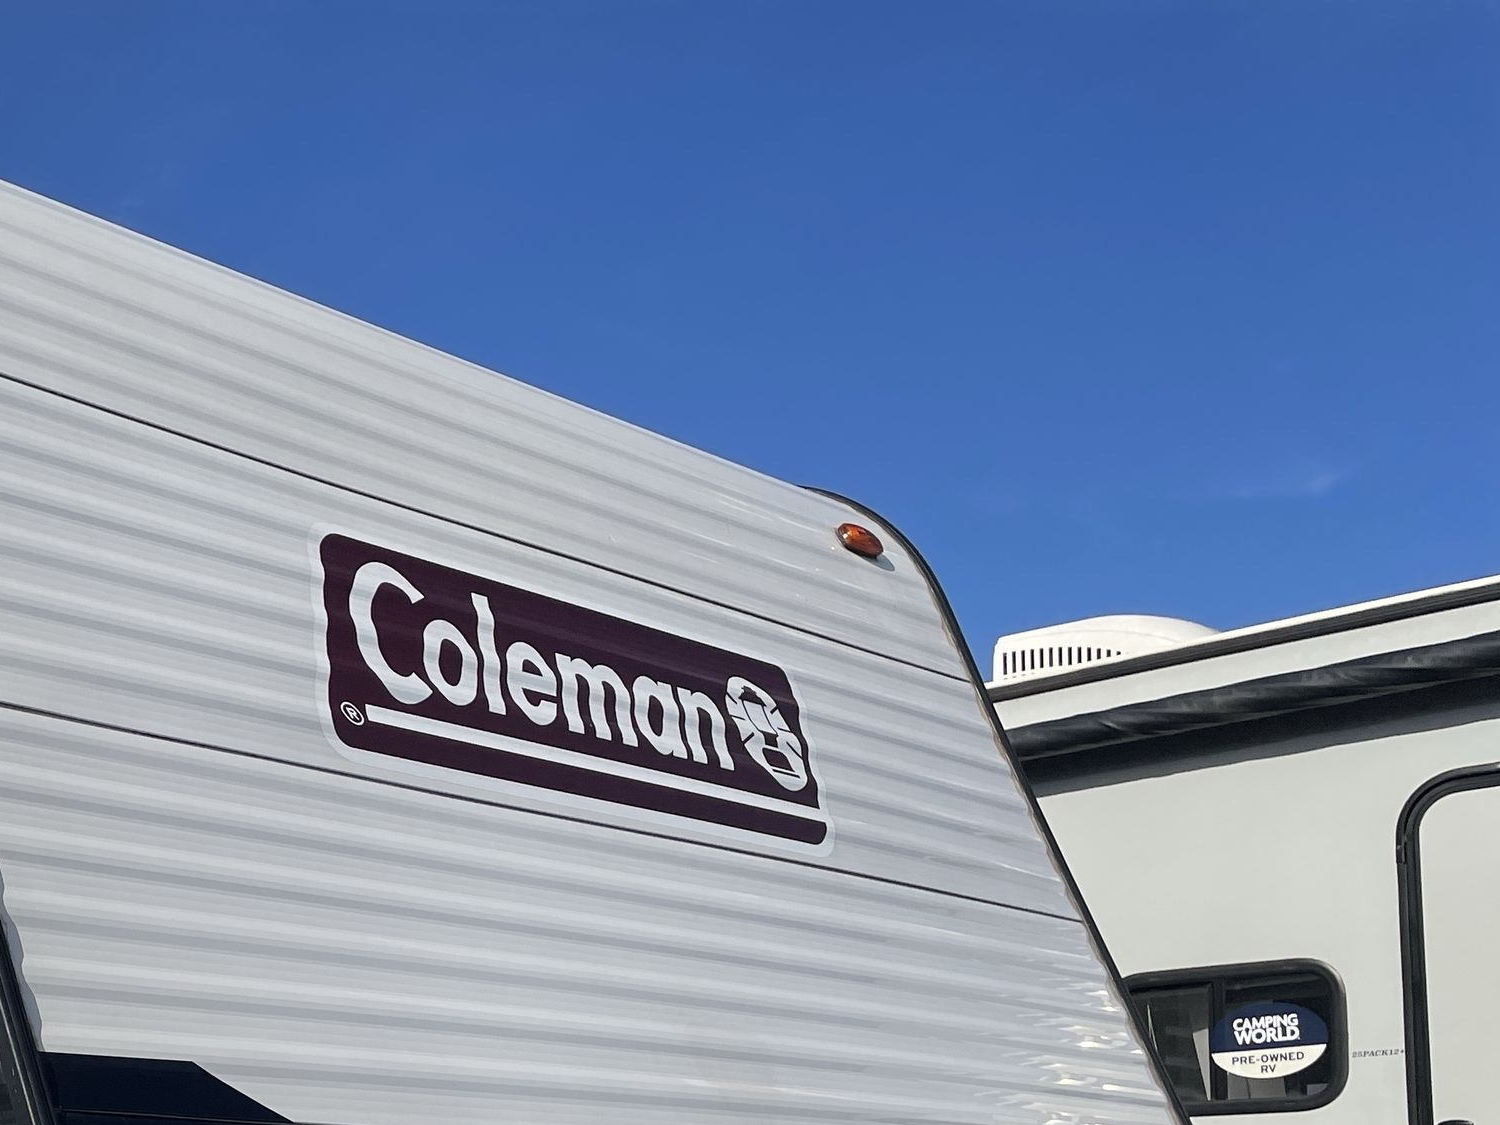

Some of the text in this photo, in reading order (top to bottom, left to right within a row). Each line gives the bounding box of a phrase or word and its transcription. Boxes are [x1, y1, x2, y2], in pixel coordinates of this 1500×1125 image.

[348, 561, 736, 772] Coleman
[1232, 1013, 1299, 1032] CAMPING
[1233, 1026, 1300, 1046] WORLD
[1231, 1051, 1305, 1066] PRE-OWNED
[1260, 1064, 1277, 1074] RV
